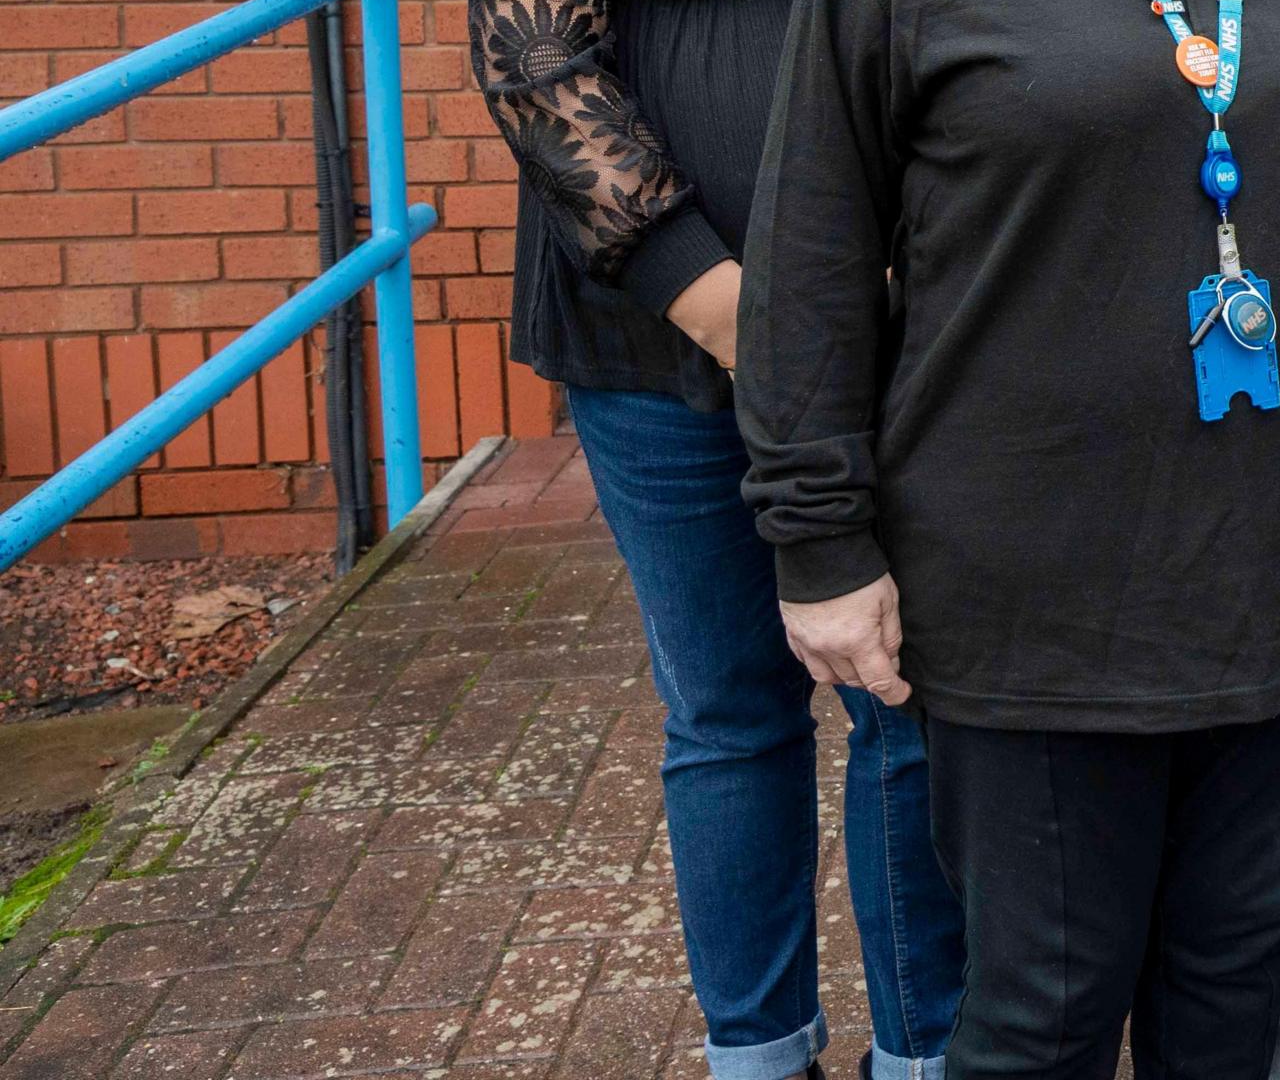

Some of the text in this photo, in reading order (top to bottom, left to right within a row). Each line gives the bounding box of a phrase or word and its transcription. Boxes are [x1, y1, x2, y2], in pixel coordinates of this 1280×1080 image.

[1222, 18, 1238, 53] NHS
[1217, 62, 1236, 102] NHS
[1217, 172, 1235, 183] NHS
[1242, 306, 1266, 334] NHS
